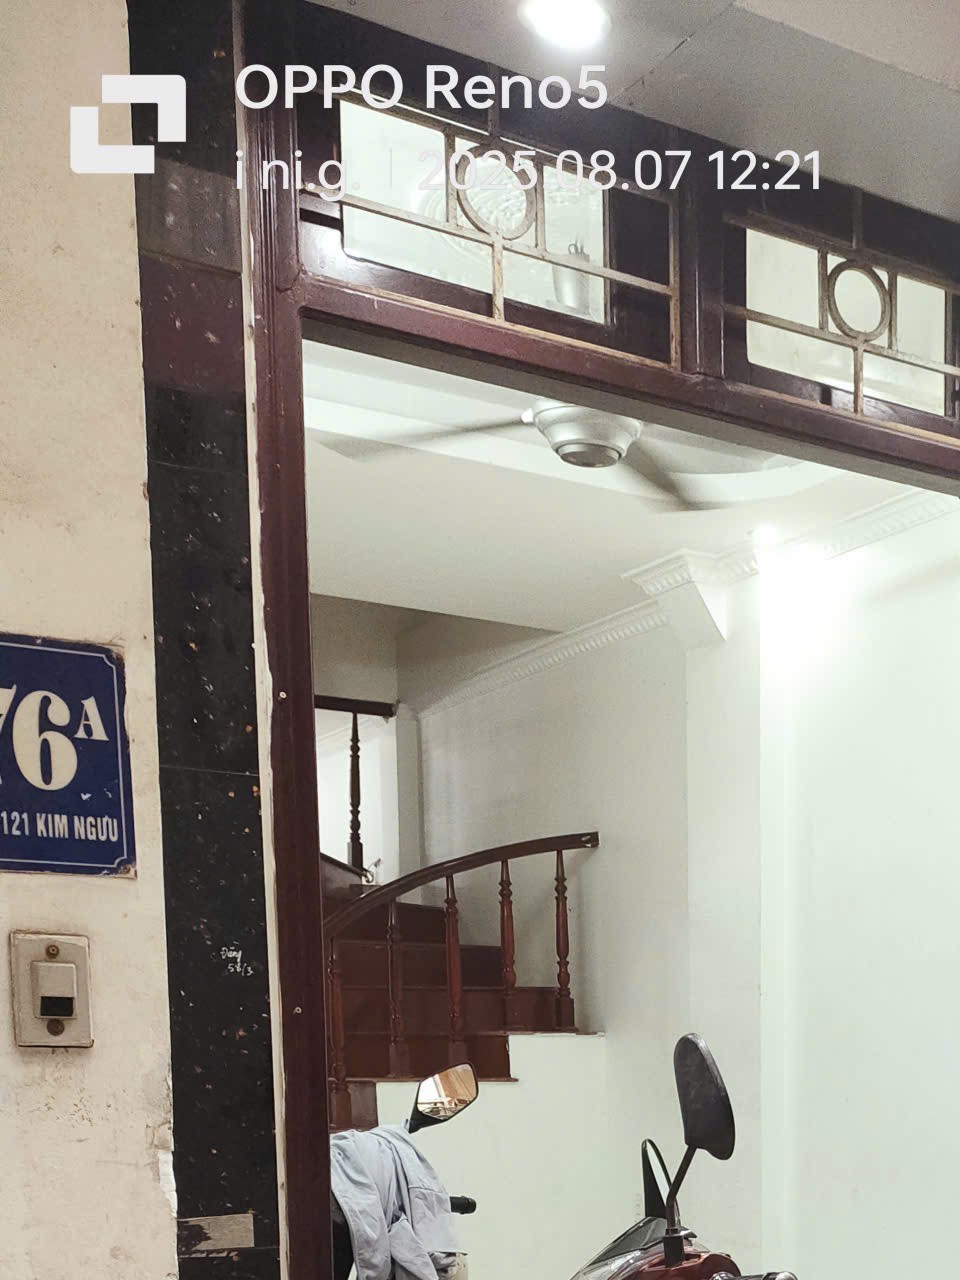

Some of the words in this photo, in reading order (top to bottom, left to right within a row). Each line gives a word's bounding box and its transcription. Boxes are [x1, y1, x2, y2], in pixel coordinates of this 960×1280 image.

[0, 811, 30, 836] 121
[36, 812, 70, 840] KIM
[73, 814, 119, 843] NGƯU
